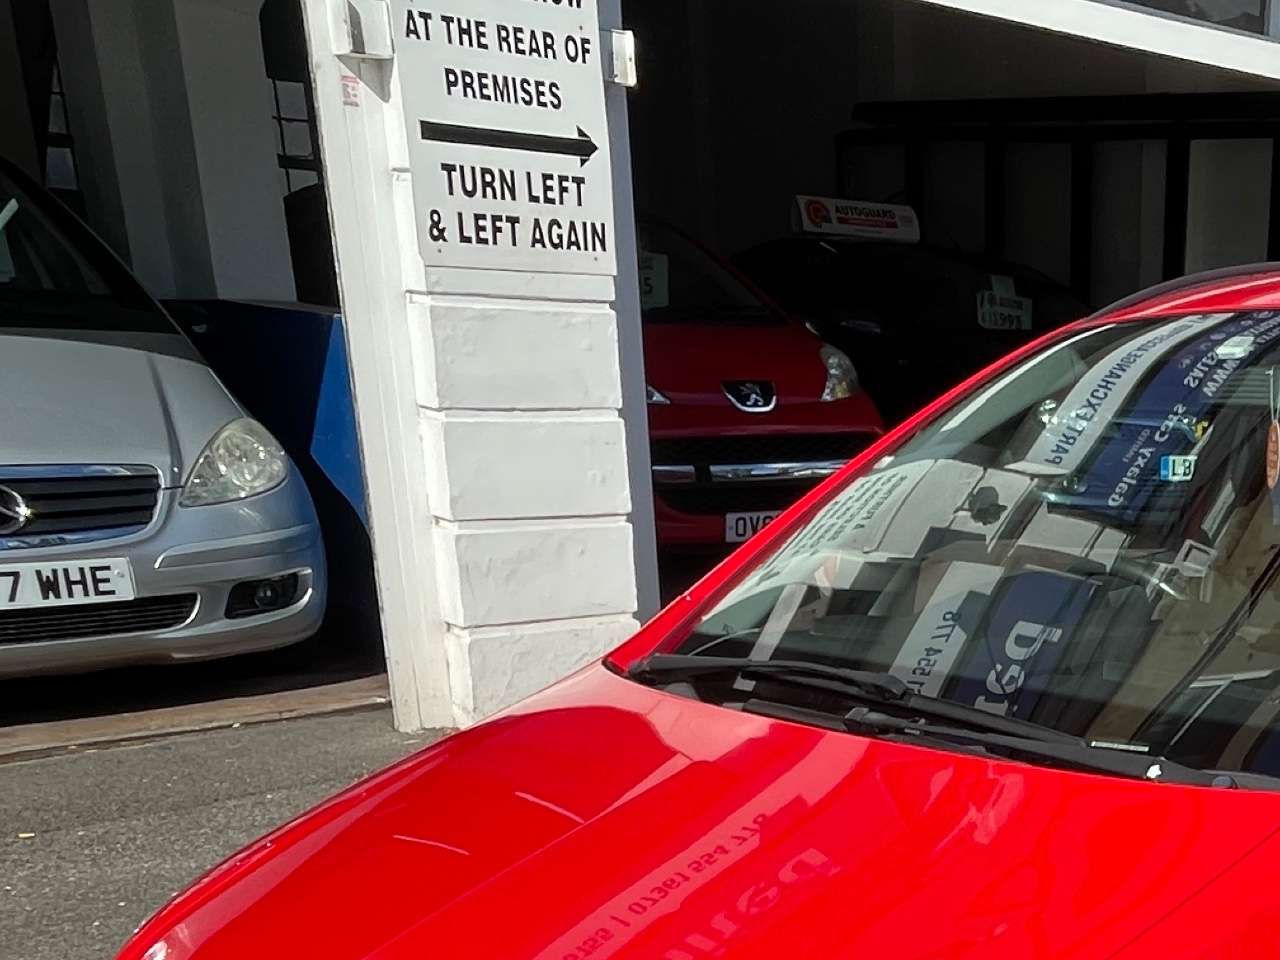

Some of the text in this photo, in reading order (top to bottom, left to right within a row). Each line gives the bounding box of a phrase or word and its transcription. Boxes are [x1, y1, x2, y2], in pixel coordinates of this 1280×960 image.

[405, 10, 591, 64] AT THE REAR OF
[444, 68, 562, 110] PREMISES
[441, 163, 585, 207] TURN LEFT
[429, 209, 607, 252] & LEFT AGAIN
[834, 205, 898, 221] AUTOGUARD
[35, 565, 116, 600] WHE
